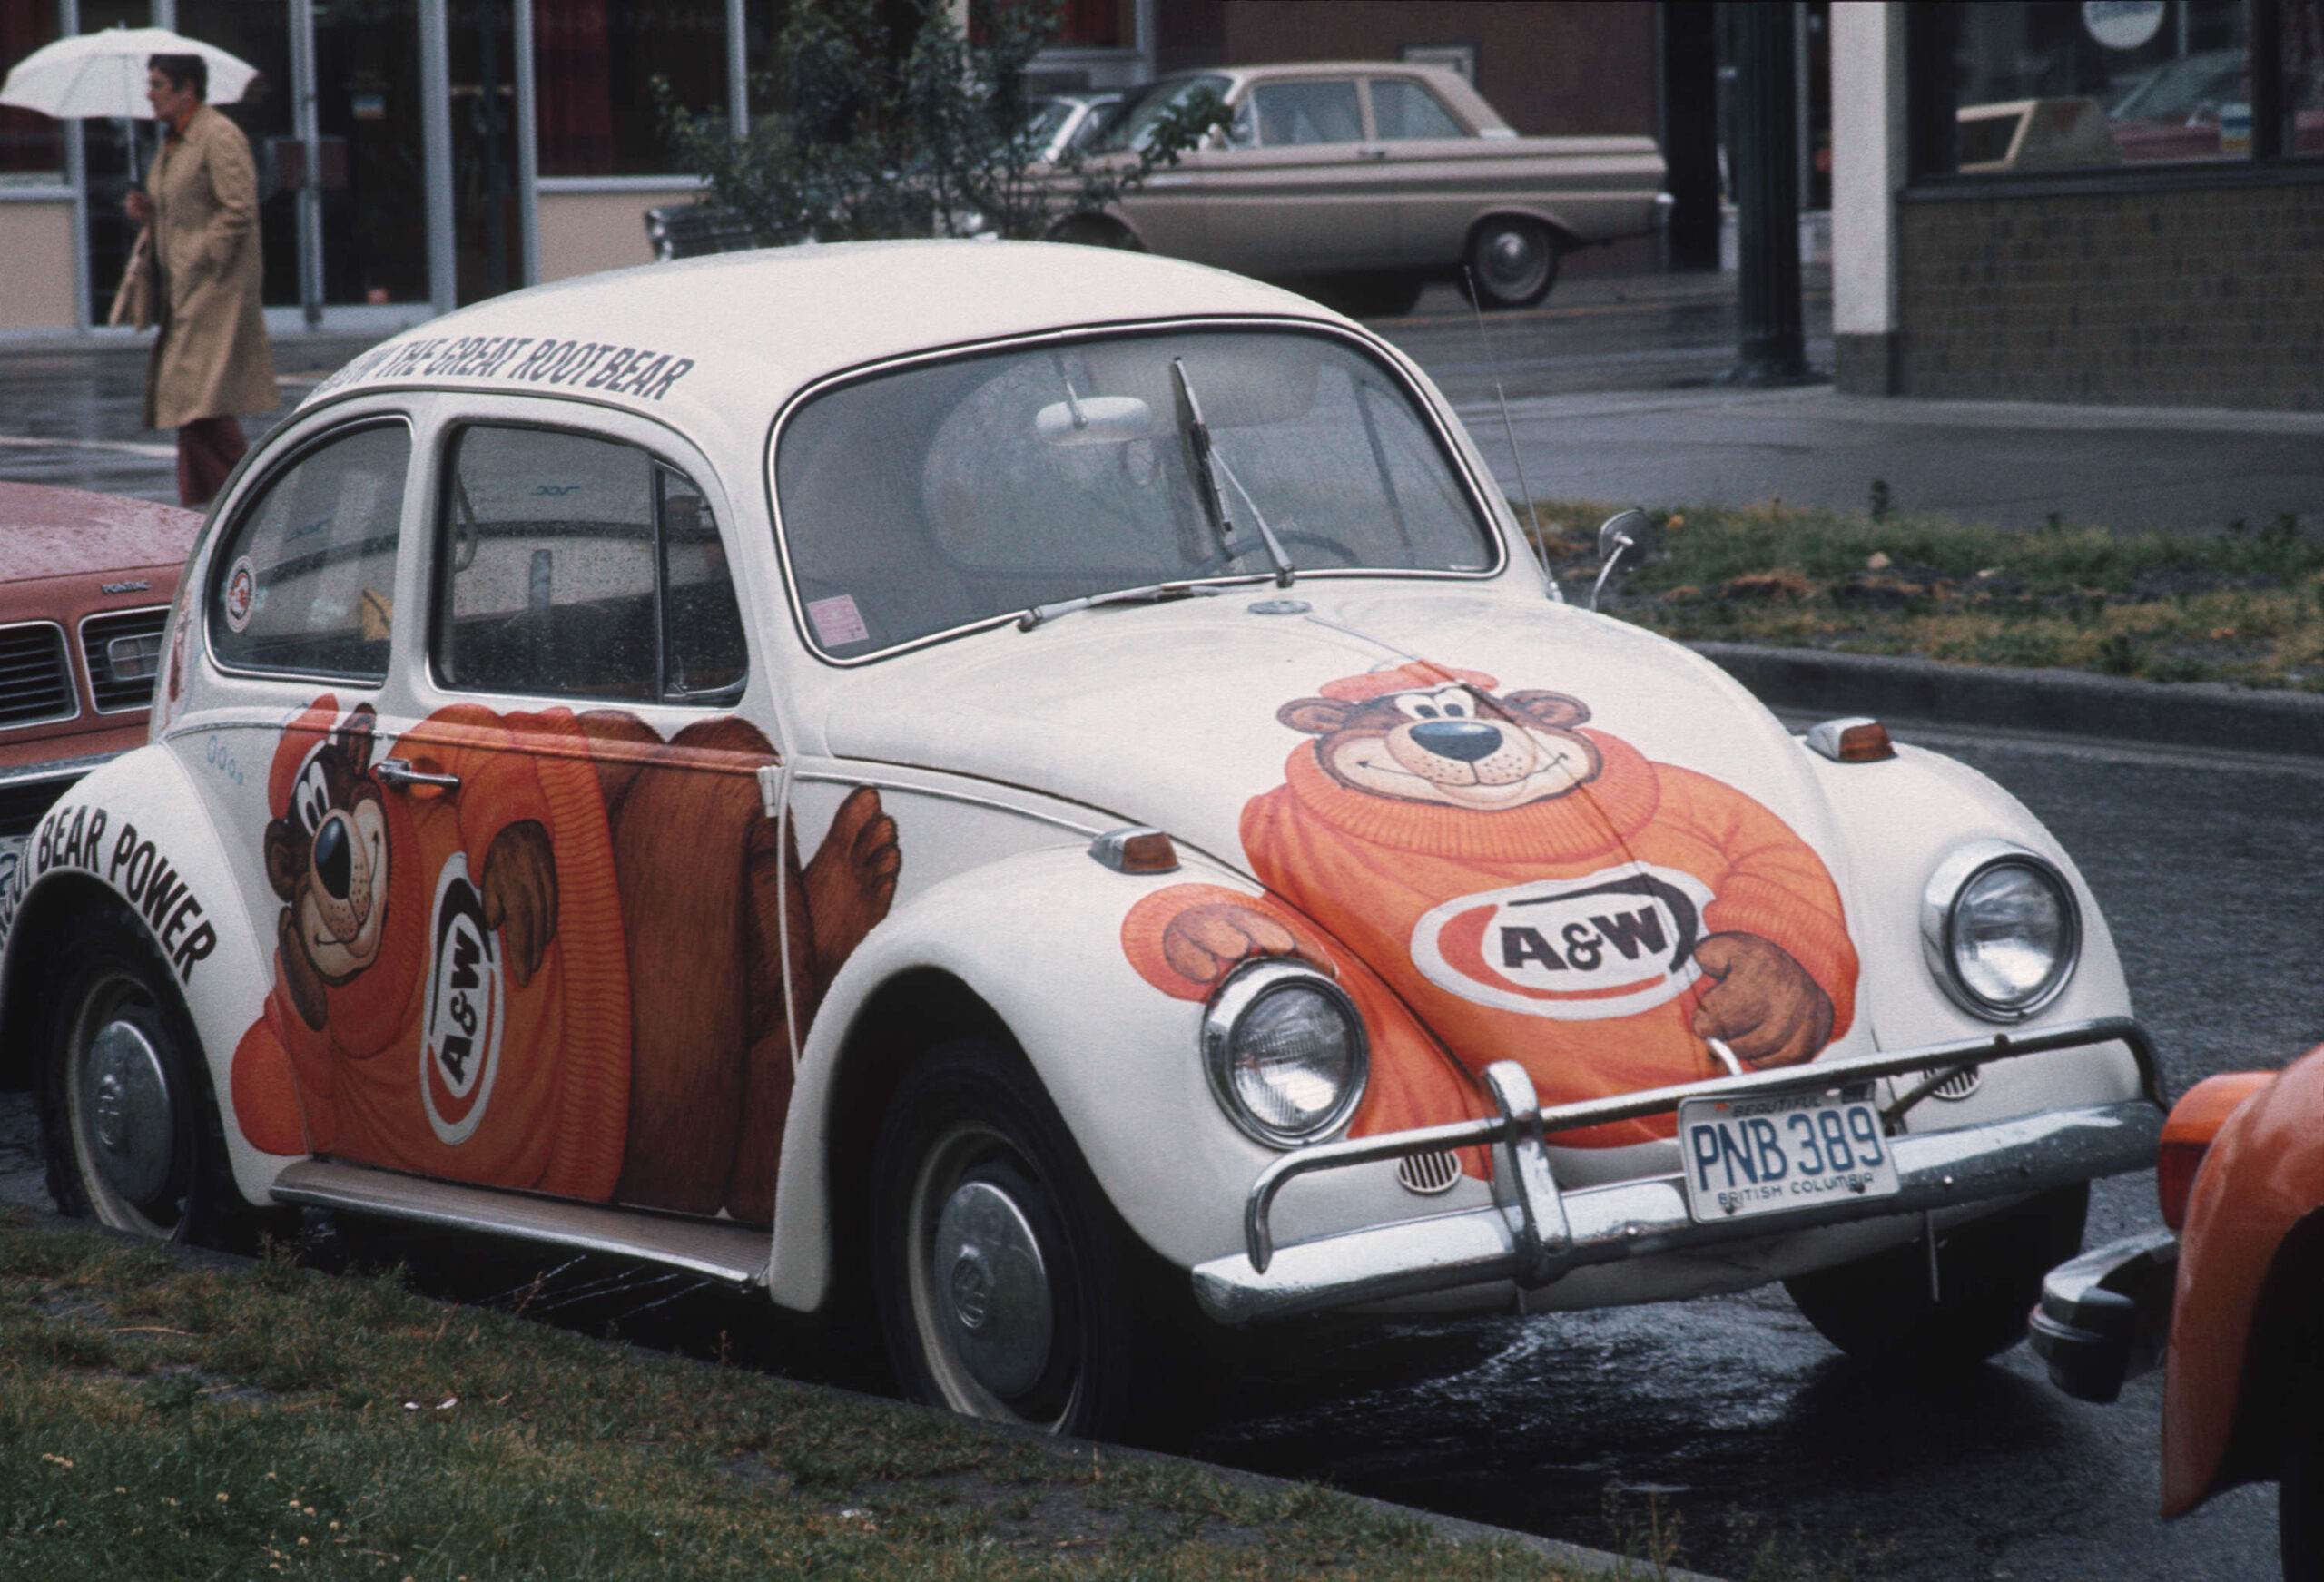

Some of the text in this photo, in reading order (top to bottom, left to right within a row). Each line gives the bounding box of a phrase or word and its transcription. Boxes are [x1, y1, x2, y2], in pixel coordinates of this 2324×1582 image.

[374, 339, 451, 378] THE
[423, 336, 535, 378] GREAT
[101, 580, 153, 594] PONTIAC
[38, 804, 108, 874] BEAR
[109, 823, 217, 986] POWER
[1500, 905, 1669, 972] A&W
[440, 925, 481, 1086] A&W
[1732, 1095, 1822, 1117] BEAUTIFUL
[1691, 1105, 1885, 1192] PNB 389
[1718, 1172, 1875, 1207] BRITISH COLUMBIA
